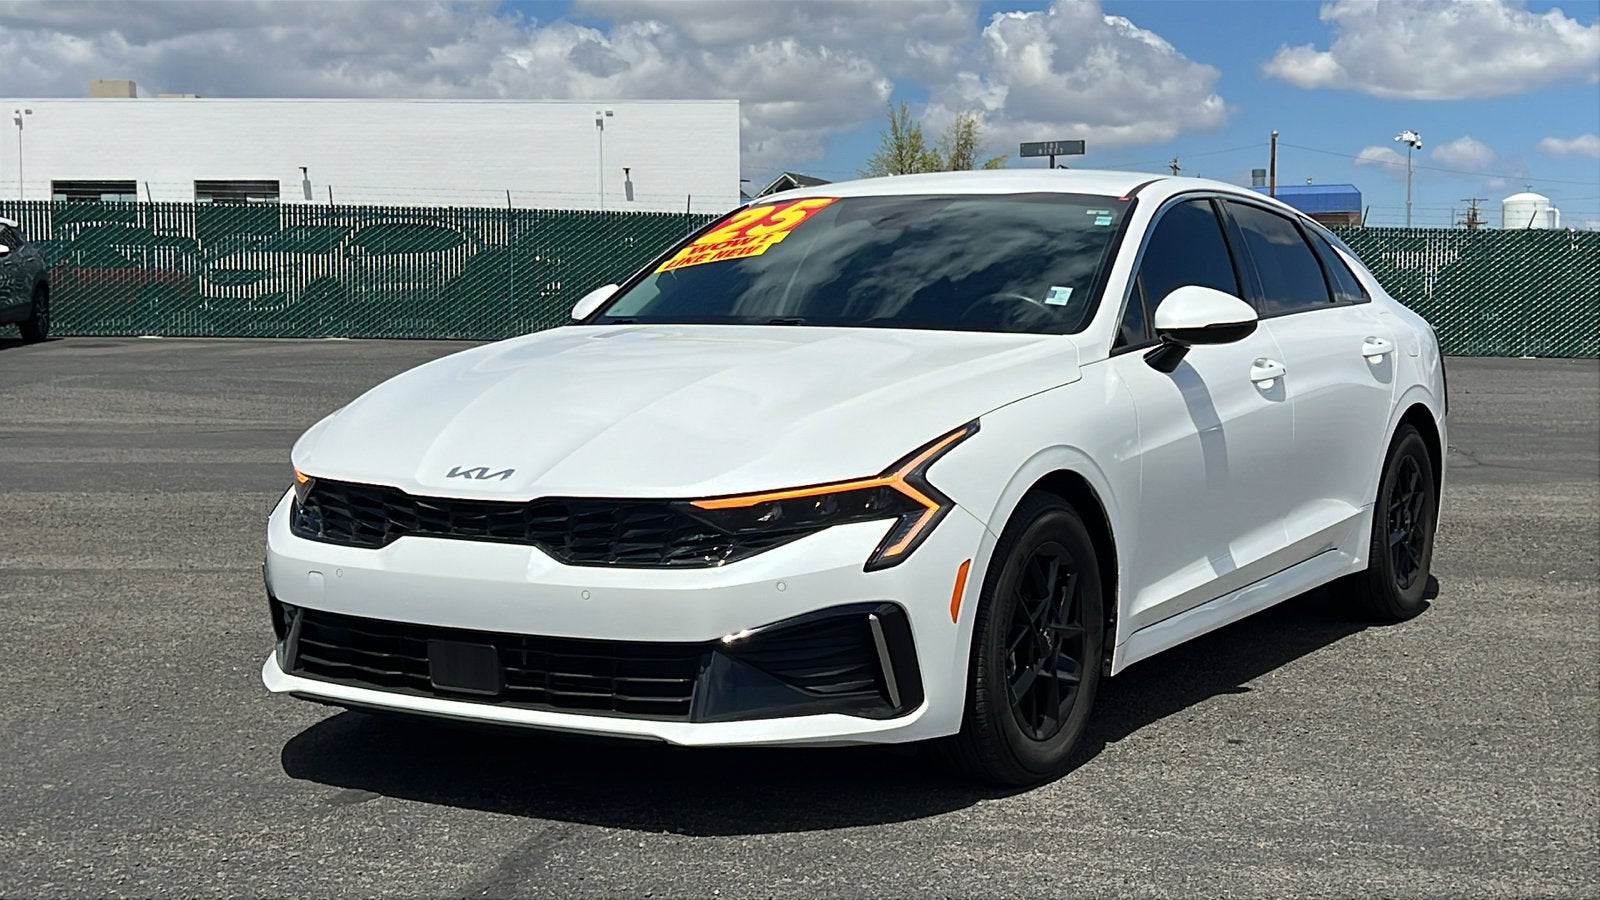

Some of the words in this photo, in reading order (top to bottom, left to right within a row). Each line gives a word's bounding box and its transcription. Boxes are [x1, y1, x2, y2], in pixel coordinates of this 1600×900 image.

[664, 253, 709, 270] LIKE
[710, 245, 761, 260] NEW
[446, 466, 516, 481] KIA
